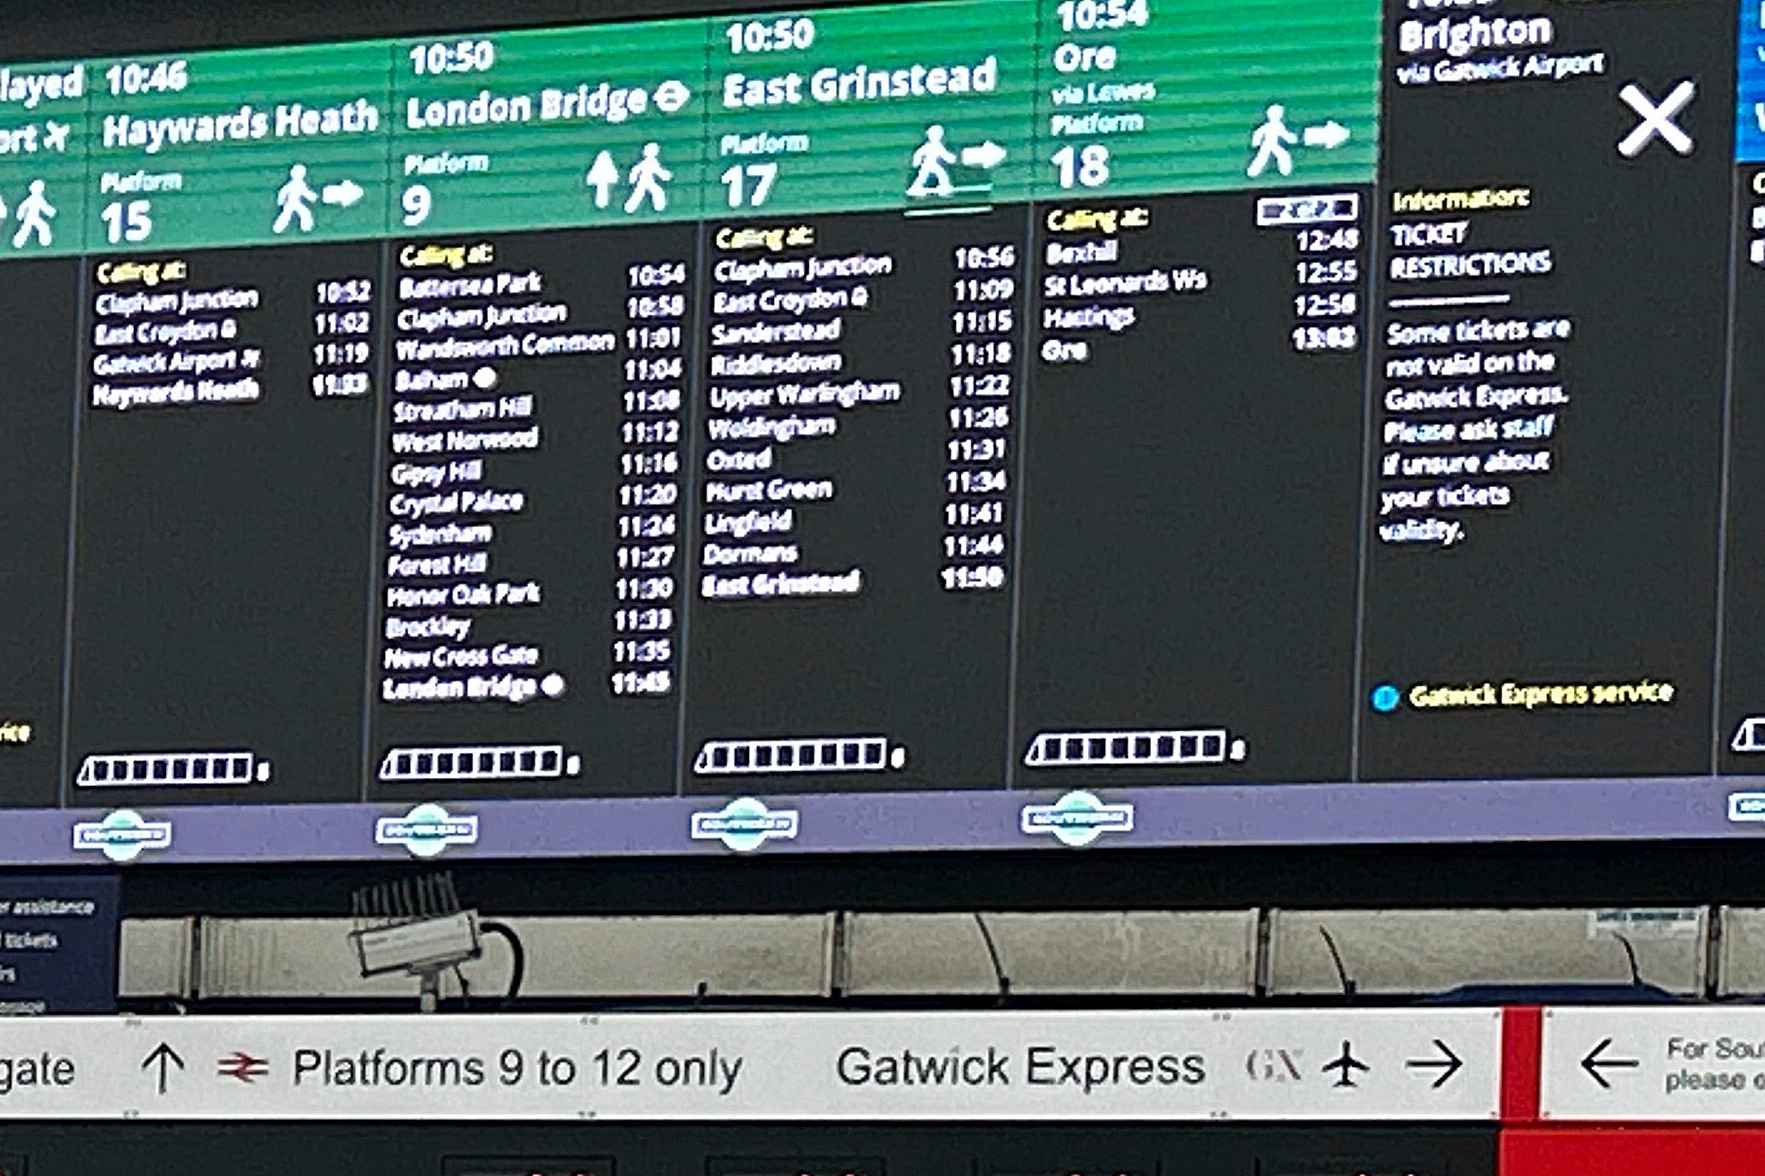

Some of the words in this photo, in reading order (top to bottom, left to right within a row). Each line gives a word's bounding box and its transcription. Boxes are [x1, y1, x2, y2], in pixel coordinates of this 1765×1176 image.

[1057, 0, 1149, 31] 10:54
[726, 18, 815, 54] 10:50
[1399, 16, 1553, 56] Brighton
[410, 40, 494, 74] 10:50
[1053, 43, 1116, 72] Ore
[1396, 63, 1430, 84] via
[1434, 56, 1520, 83] Gatwick
[1523, 51, 1606, 78] Airport
[106, 60, 186, 96] 10:46
[723, 72, 802, 108] East
[811, 55, 997, 101] Grinstead
[406, 90, 531, 129] London
[539, 83, 648, 123] Bridge
[103, 105, 268, 154] Haywards
[275, 98, 379, 136] Heath
[1051, 112, 1143, 136] Platform
[721, 131, 809, 156] Platform
[404, 152, 488, 176] Platform
[1051, 144, 1109, 189] 18
[101, 170, 182, 193] Platform
[721, 162, 778, 208] 17
[101, 200, 152, 243] 15
[402, 185, 432, 227] 9
[1389, 219, 1470, 246] TICKET
[1390, 250, 1552, 279] RESTRICTIONS
[1387, 320, 1450, 346] Some
[1455, 319, 1529, 344] tickets
[1532, 319, 1571, 339] are
[1386, 356, 1424, 378] not
[1427, 352, 1480, 376] valid
[1483, 355, 1514, 374] on
[1517, 349, 1555, 372] the
[1409, 682, 1496, 709] Gatwick
[1501, 682, 1589, 710] Express
[1592, 679, 1675, 704] service
[1667, 1037, 1709, 1060] For
[293, 1048, 484, 1086] Platforms
[500, 1049, 523, 1085] 9
[540, 1052, 575, 1086] to
[600, 1049, 642, 1086] 12
[656, 1047, 743, 1095] only
[837, 1045, 1010, 1088] Gatwick
[1027, 1046, 1206, 1094] Express
[1665, 1069, 1746, 1094] please
